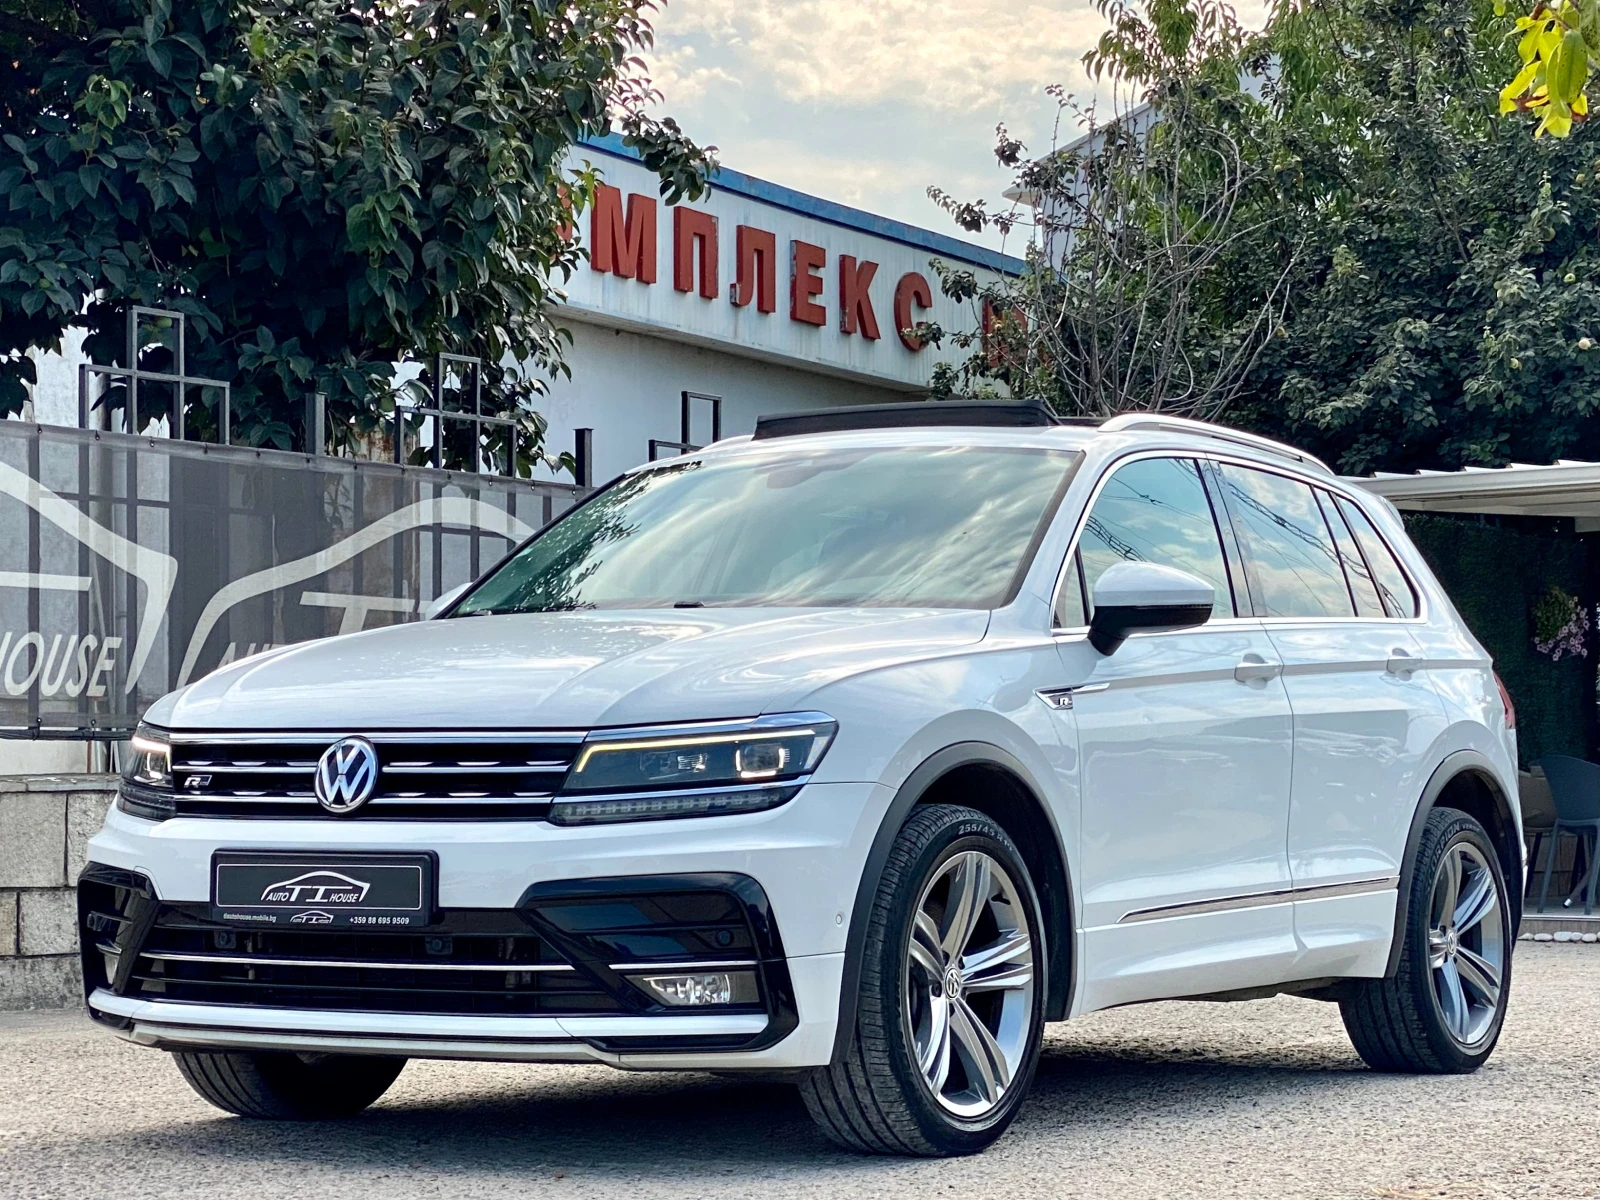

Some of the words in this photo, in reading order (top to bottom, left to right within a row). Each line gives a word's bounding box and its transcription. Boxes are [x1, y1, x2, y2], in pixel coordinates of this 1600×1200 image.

[548, 182, 934, 354] МПЛЕКС
[316, 737, 377, 813] VW
[958, 823, 995, 836] 255/45
[265, 892, 290, 902] AUTO
[328, 893, 359, 903] HOUSE
[349, 916, 366, 924] +359
[367, 916, 377, 924] 88
[377, 916, 391, 924] 695
[391, 916, 410, 925] 9509
